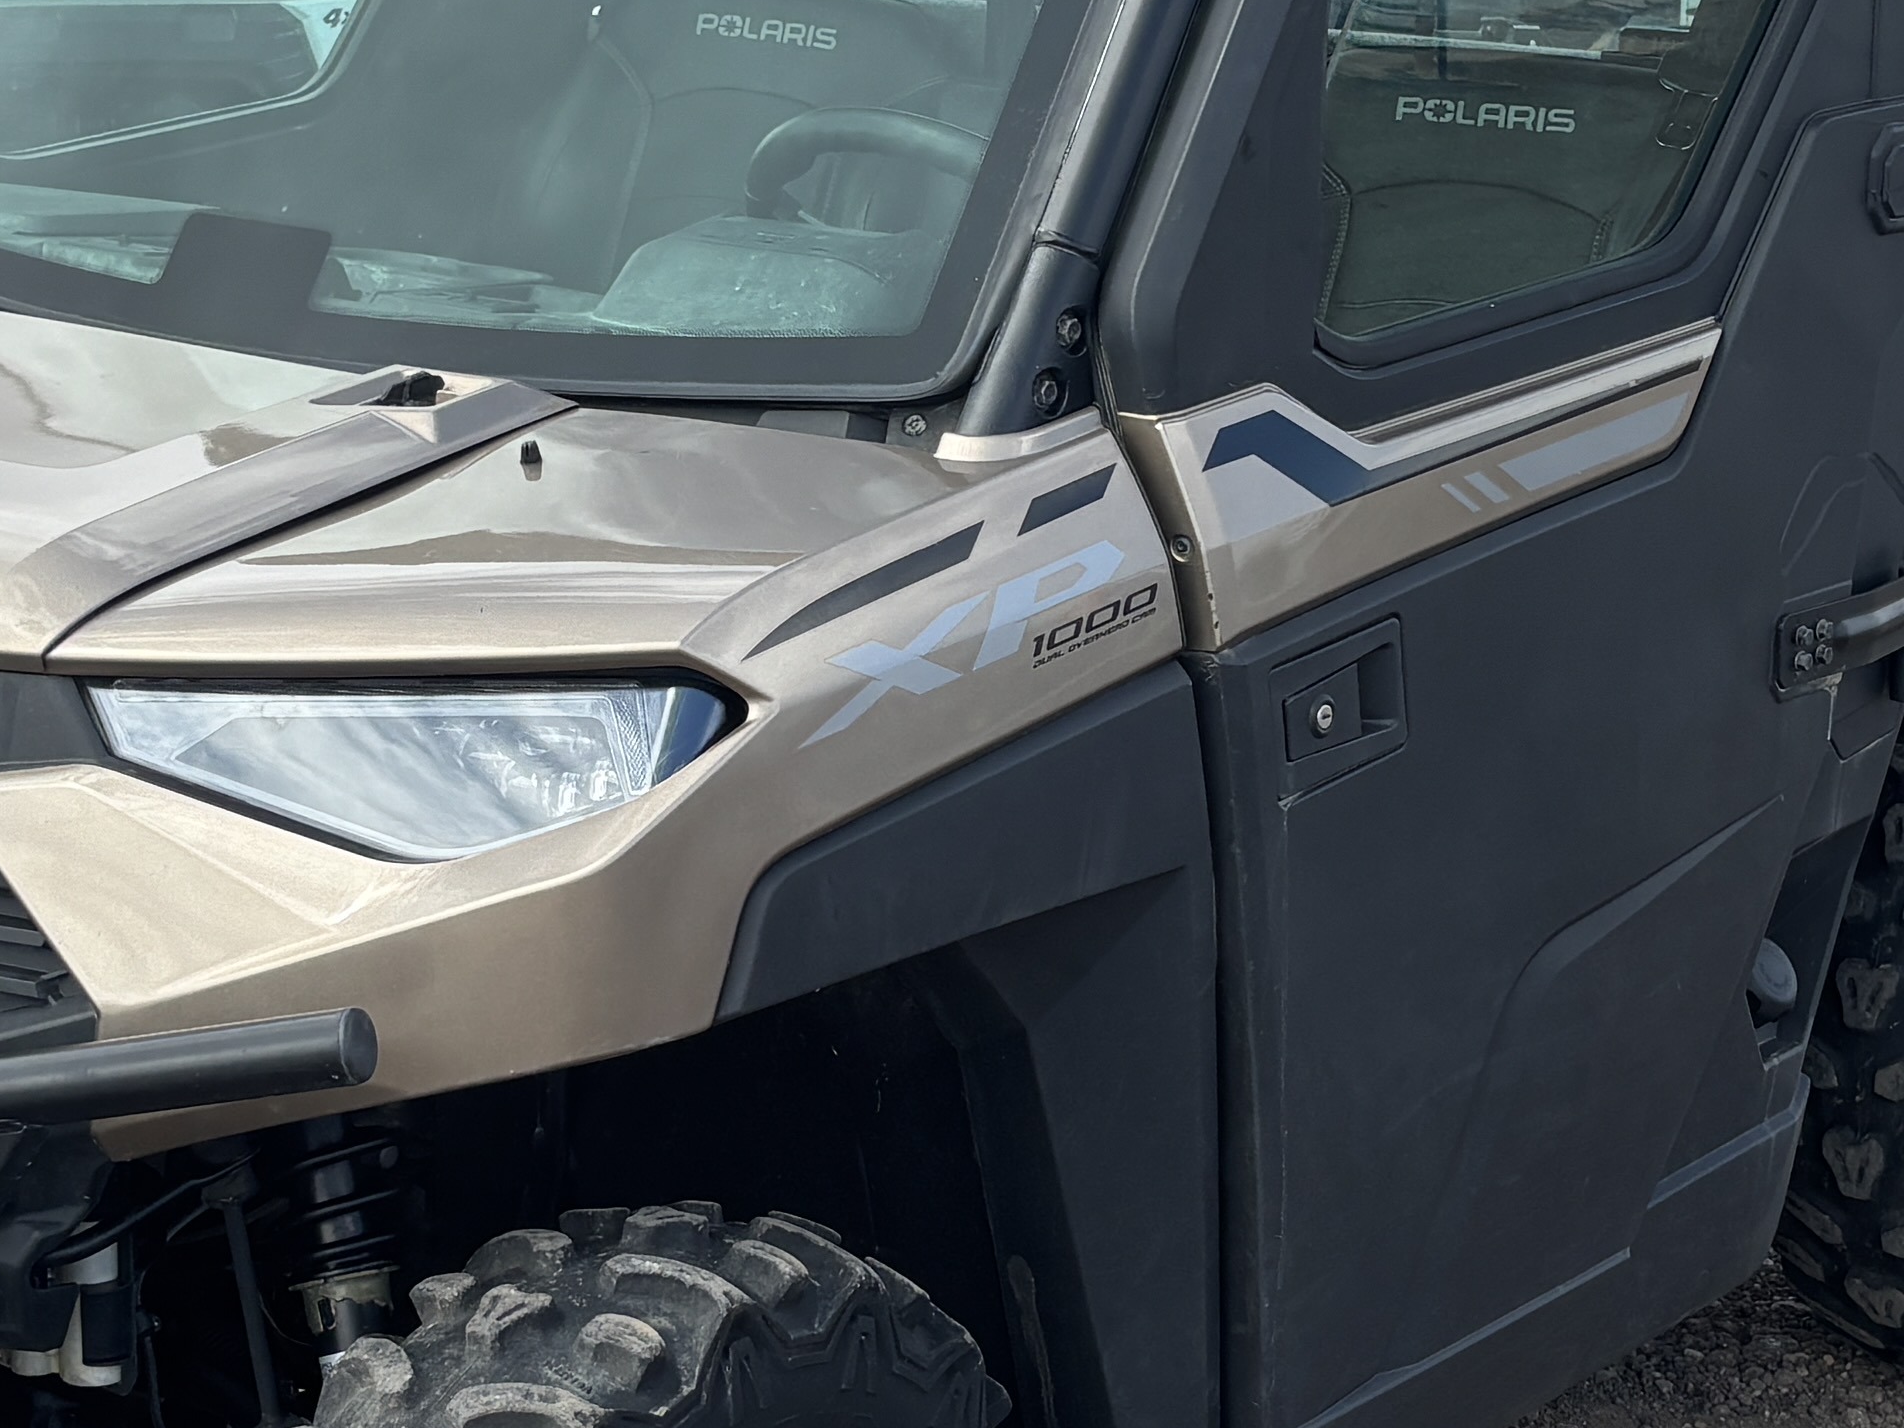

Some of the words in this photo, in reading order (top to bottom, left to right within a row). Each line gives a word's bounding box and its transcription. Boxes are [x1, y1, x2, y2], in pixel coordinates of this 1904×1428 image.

[696, 13, 837, 50] POLARIS
[1396, 96, 1576, 133] POLARIS
[798, 540, 1125, 749] XP
[1033, 583, 1158, 658] 1000
